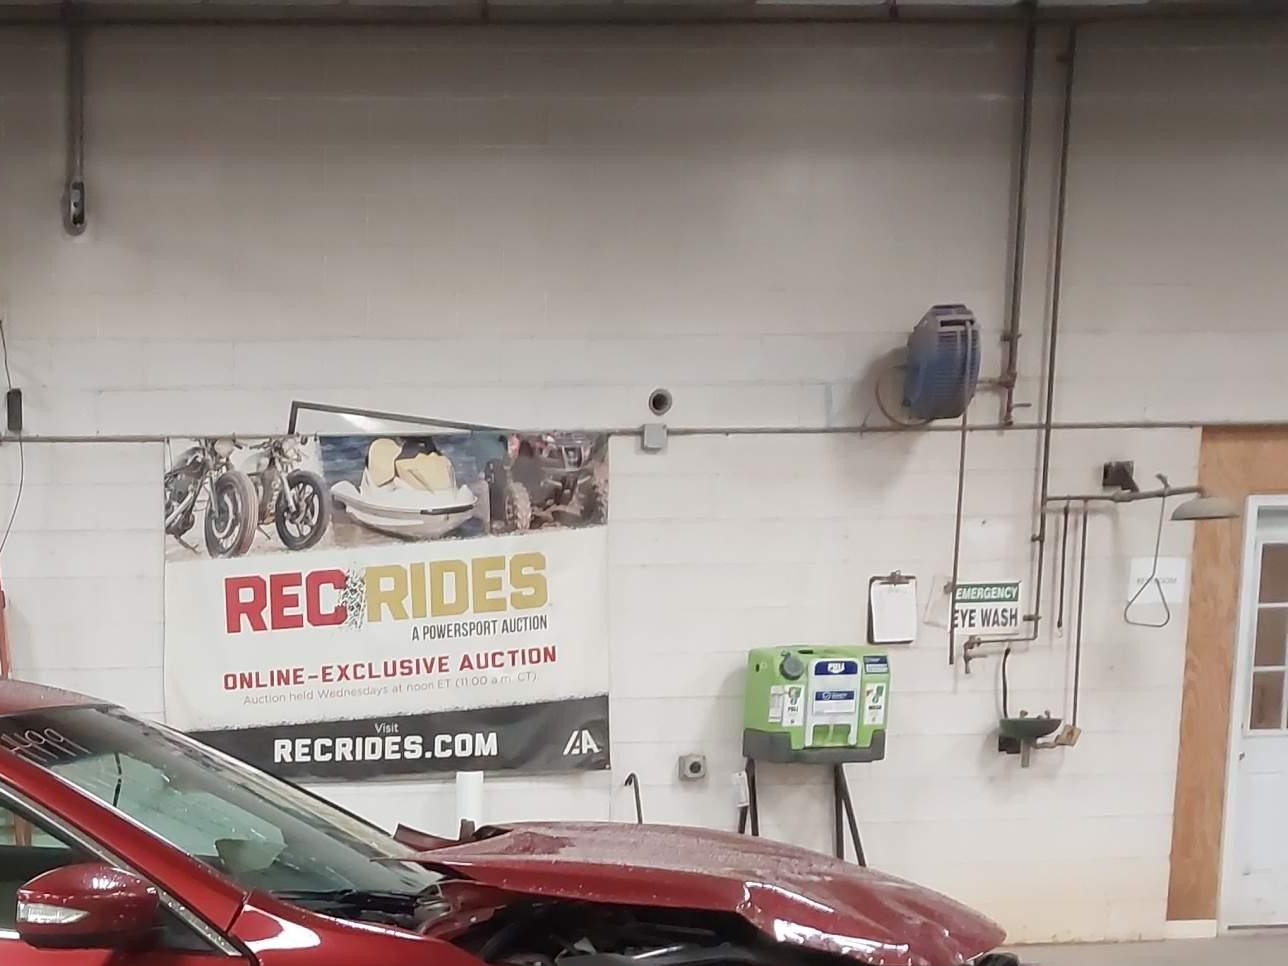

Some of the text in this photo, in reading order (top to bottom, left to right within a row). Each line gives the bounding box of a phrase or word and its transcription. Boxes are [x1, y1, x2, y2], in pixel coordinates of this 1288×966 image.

[224, 552, 549, 633] REC RIDES
[955, 586, 1018, 600] EMERGENCY
[412, 614, 548, 641] A POWERSPORT AUCTION
[953, 607, 1018, 629] EYE WASH
[224, 645, 557, 691] ONLINE-EXCLUSIVE AUCTION
[243, 692, 286, 705] Auction
[290, 690, 313, 702] held
[317, 683, 389, 700] Wednesdays
[392, 683, 403, 694] at
[406, 683, 434, 693] noon
[437, 679, 451, 689] ET
[455, 675, 488, 689] (1100
[517, 671, 537, 683] CT)
[374, 722, 400, 734] Visit
[273, 731, 499, 764] RECRIDES.COM
